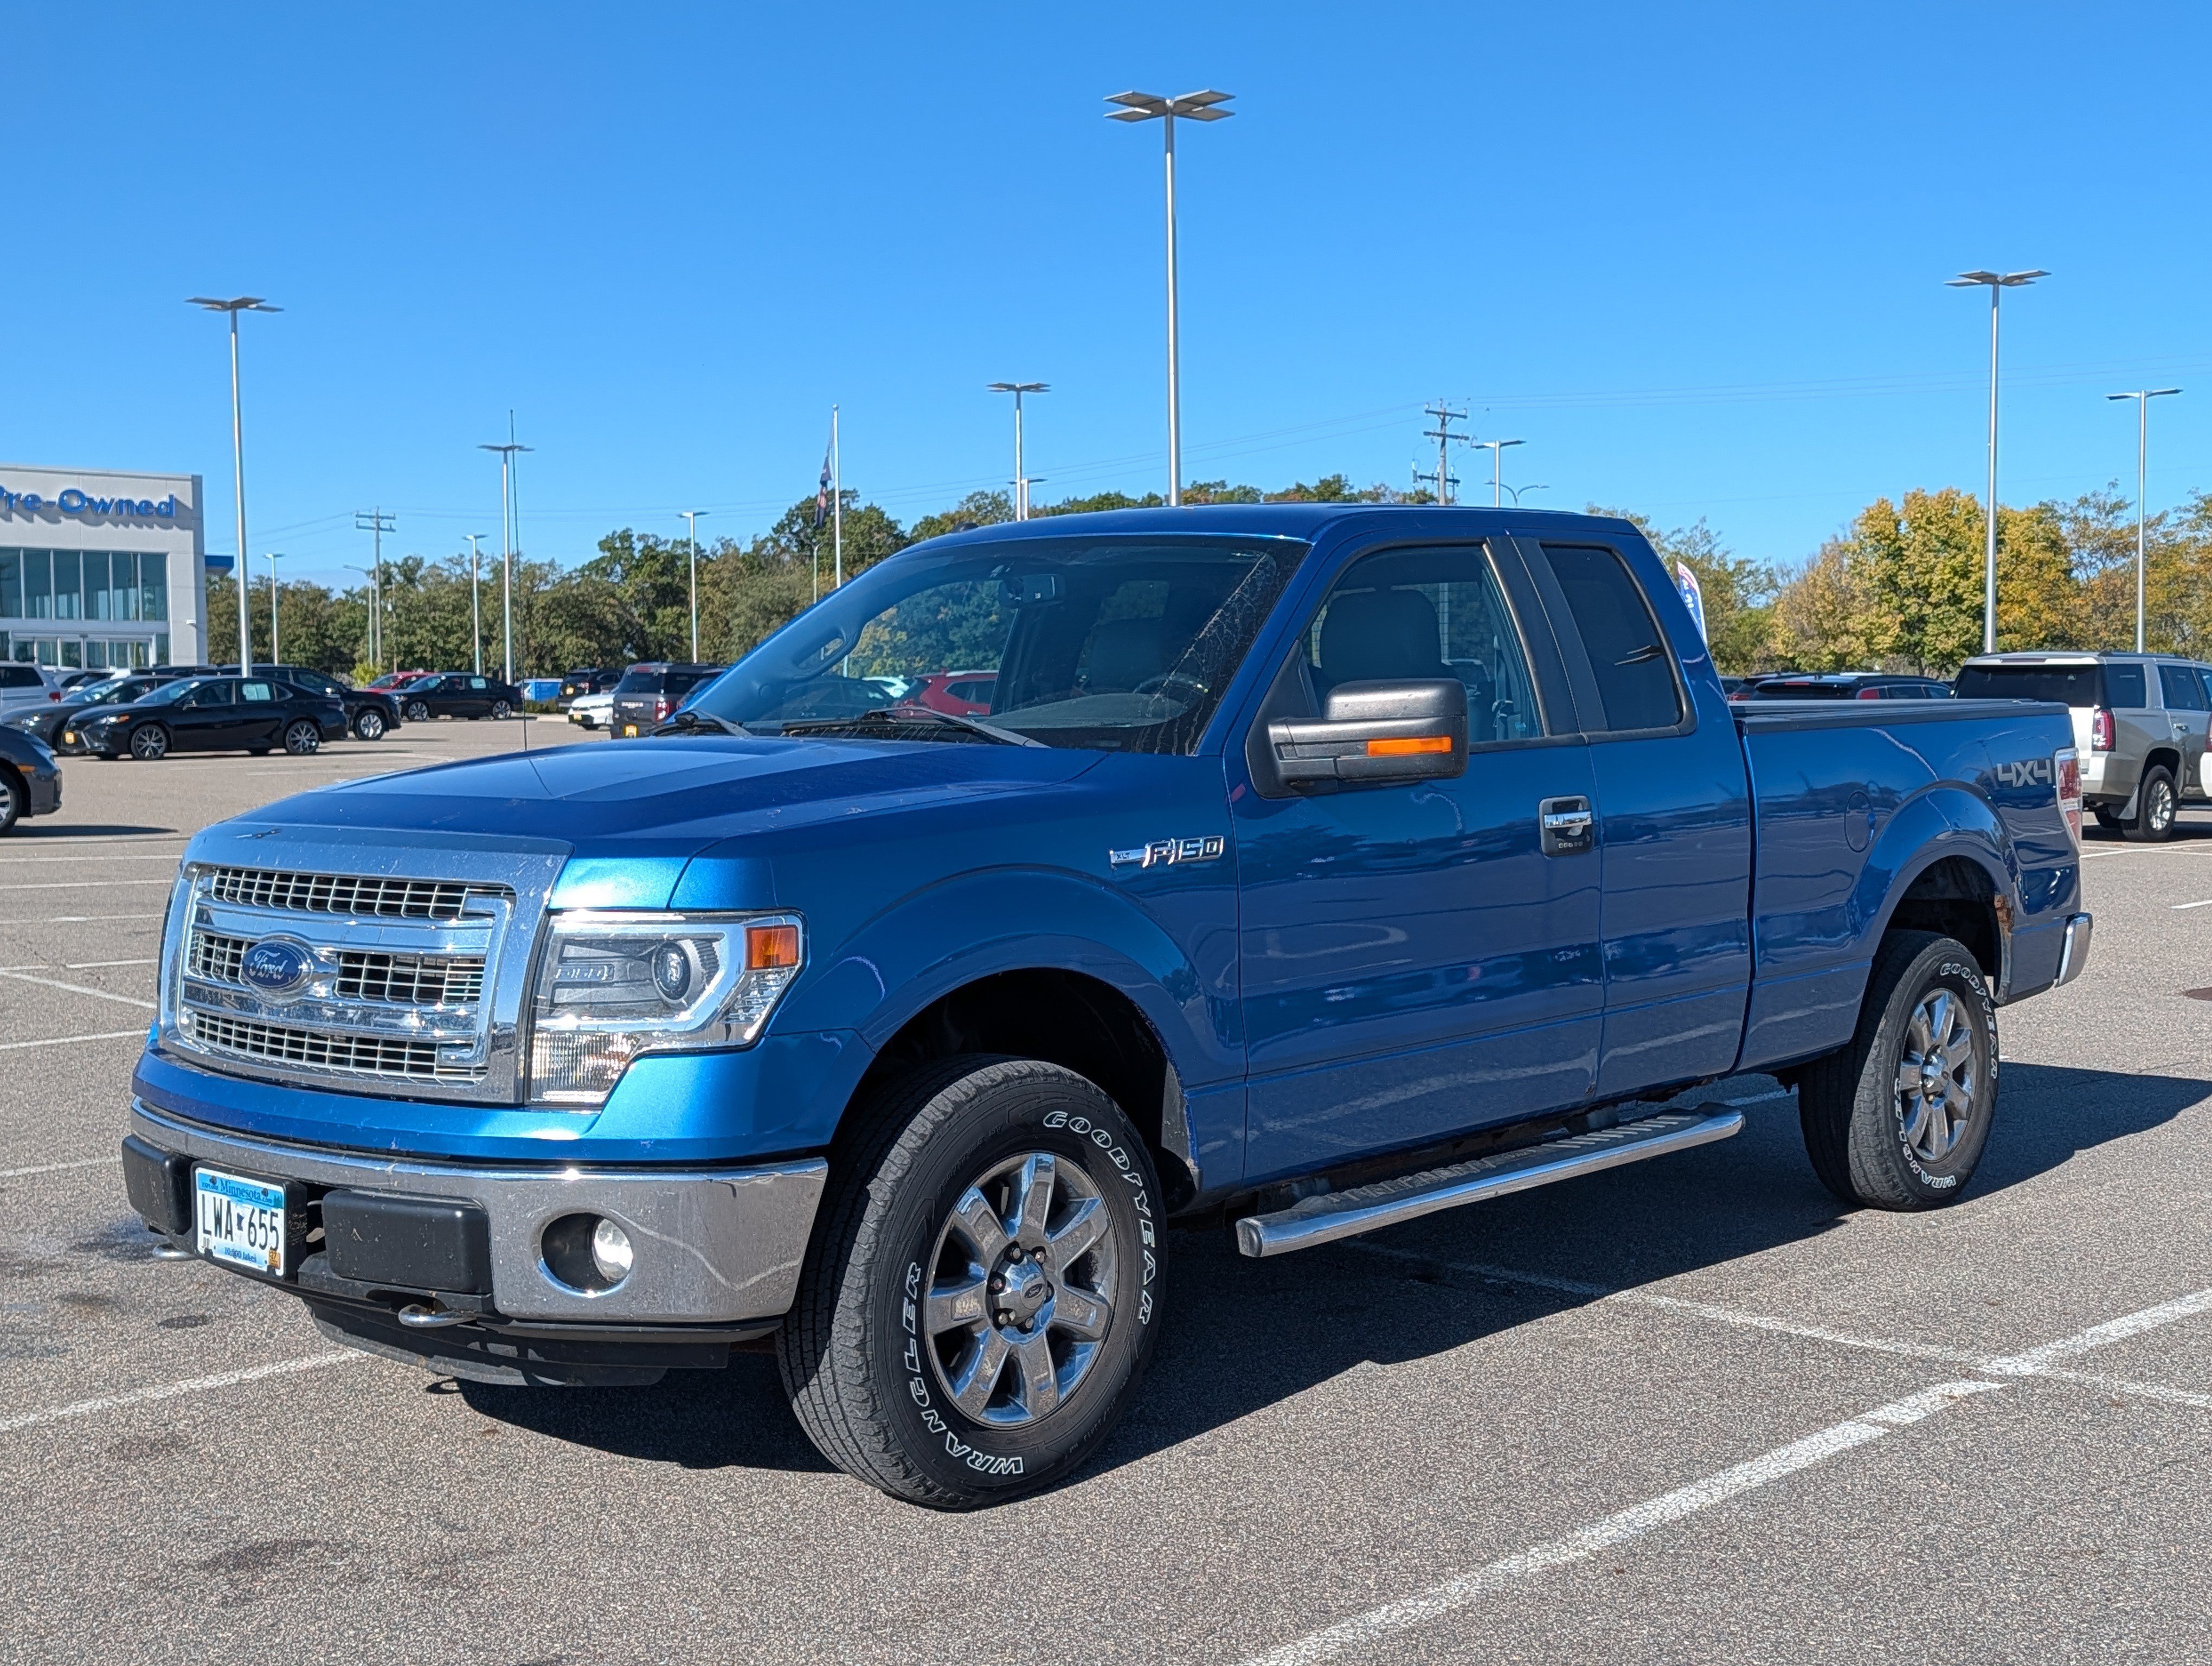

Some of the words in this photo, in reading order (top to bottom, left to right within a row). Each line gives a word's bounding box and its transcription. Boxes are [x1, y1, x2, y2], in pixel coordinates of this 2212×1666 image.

[248, 949, 288, 981] Ford
[1939, 963, 1998, 1080] GOODYEAR
[202, 1194, 234, 1242] LWA
[248, 1207, 279, 1251] 655
[1043, 1110, 1157, 1326] GOODYEAR
[902, 1260, 1025, 1476] WRANGLER
